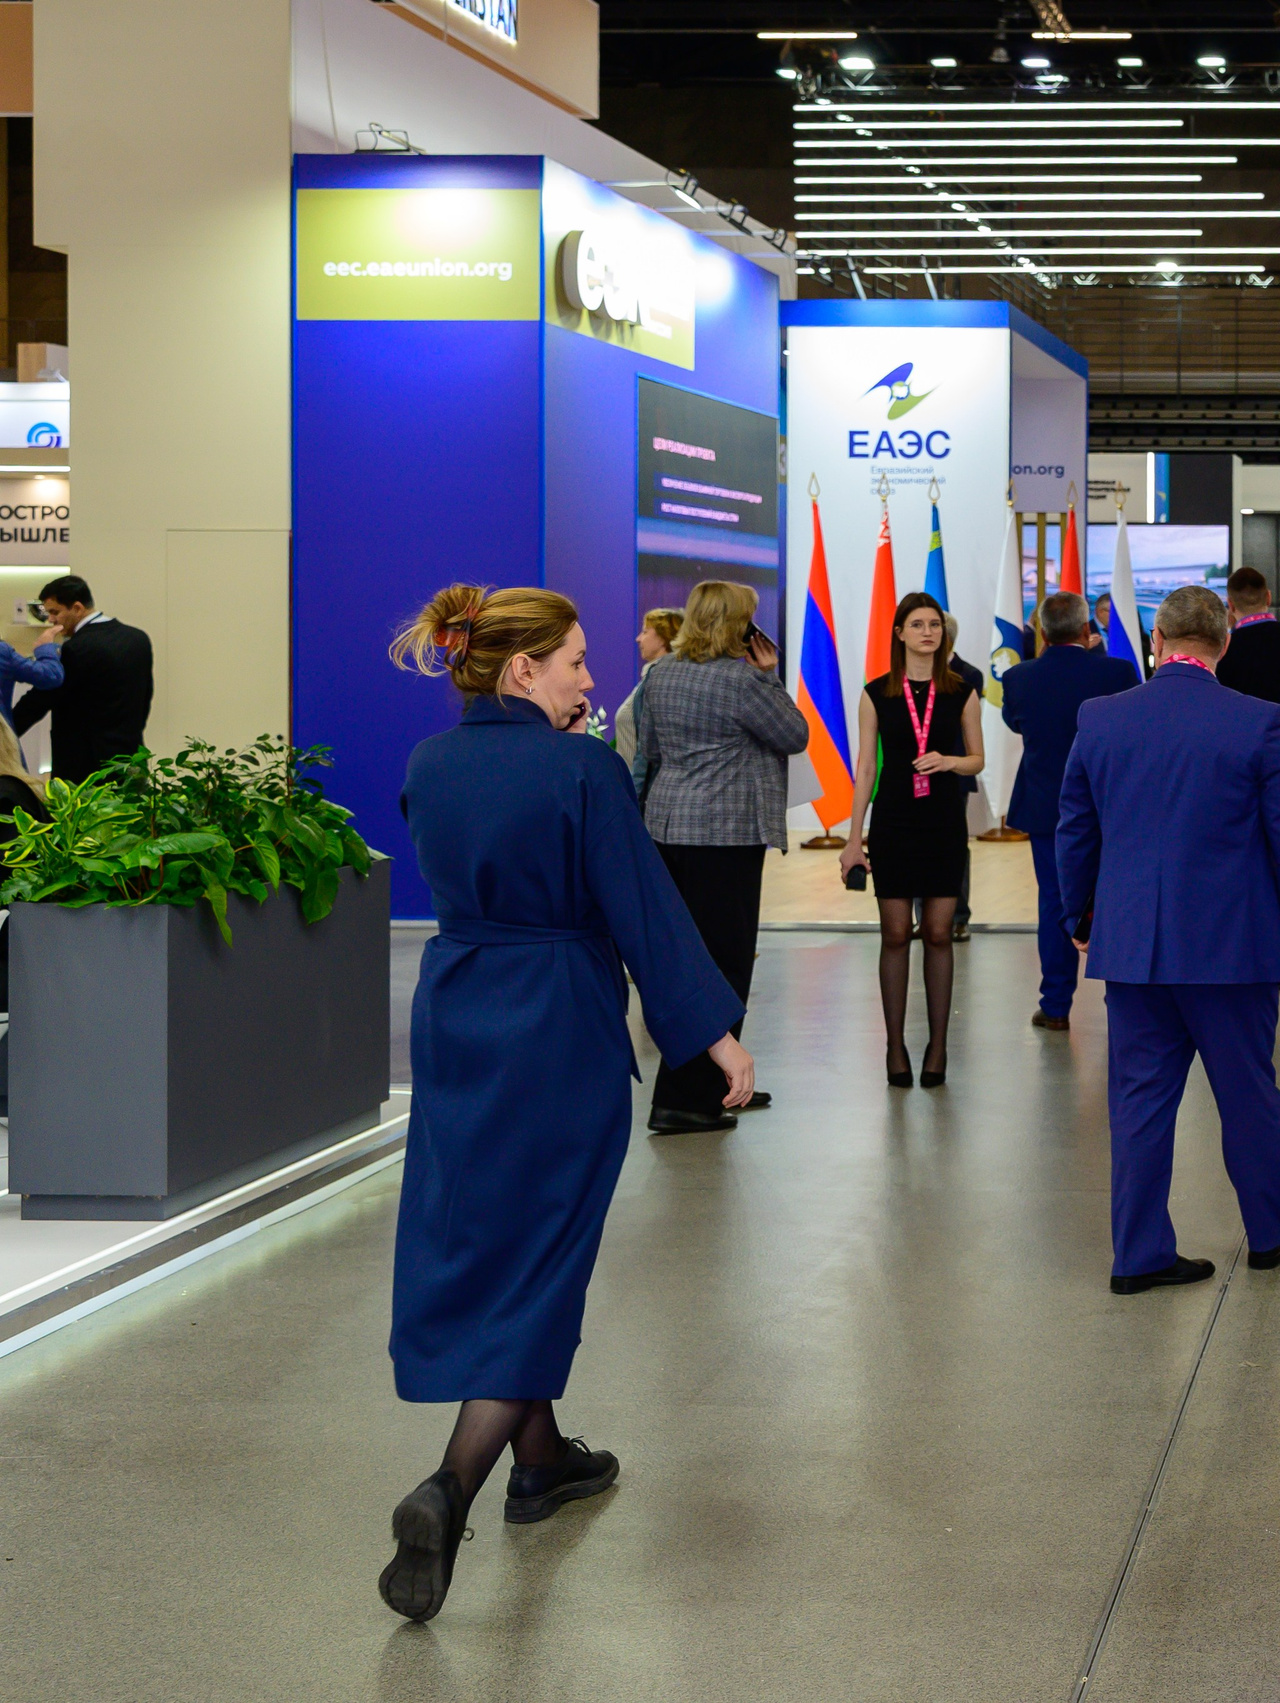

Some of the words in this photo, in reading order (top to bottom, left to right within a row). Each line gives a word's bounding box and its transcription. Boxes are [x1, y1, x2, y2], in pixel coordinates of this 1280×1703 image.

[323, 257, 513, 281] eec.eaeunion.org
[848, 430, 951, 459] ЕАЭС
[1011, 463, 1065, 478] on.org
[0, 505, 69, 520] ОСТРО
[0, 528, 69, 543] ЫШЛЕ
